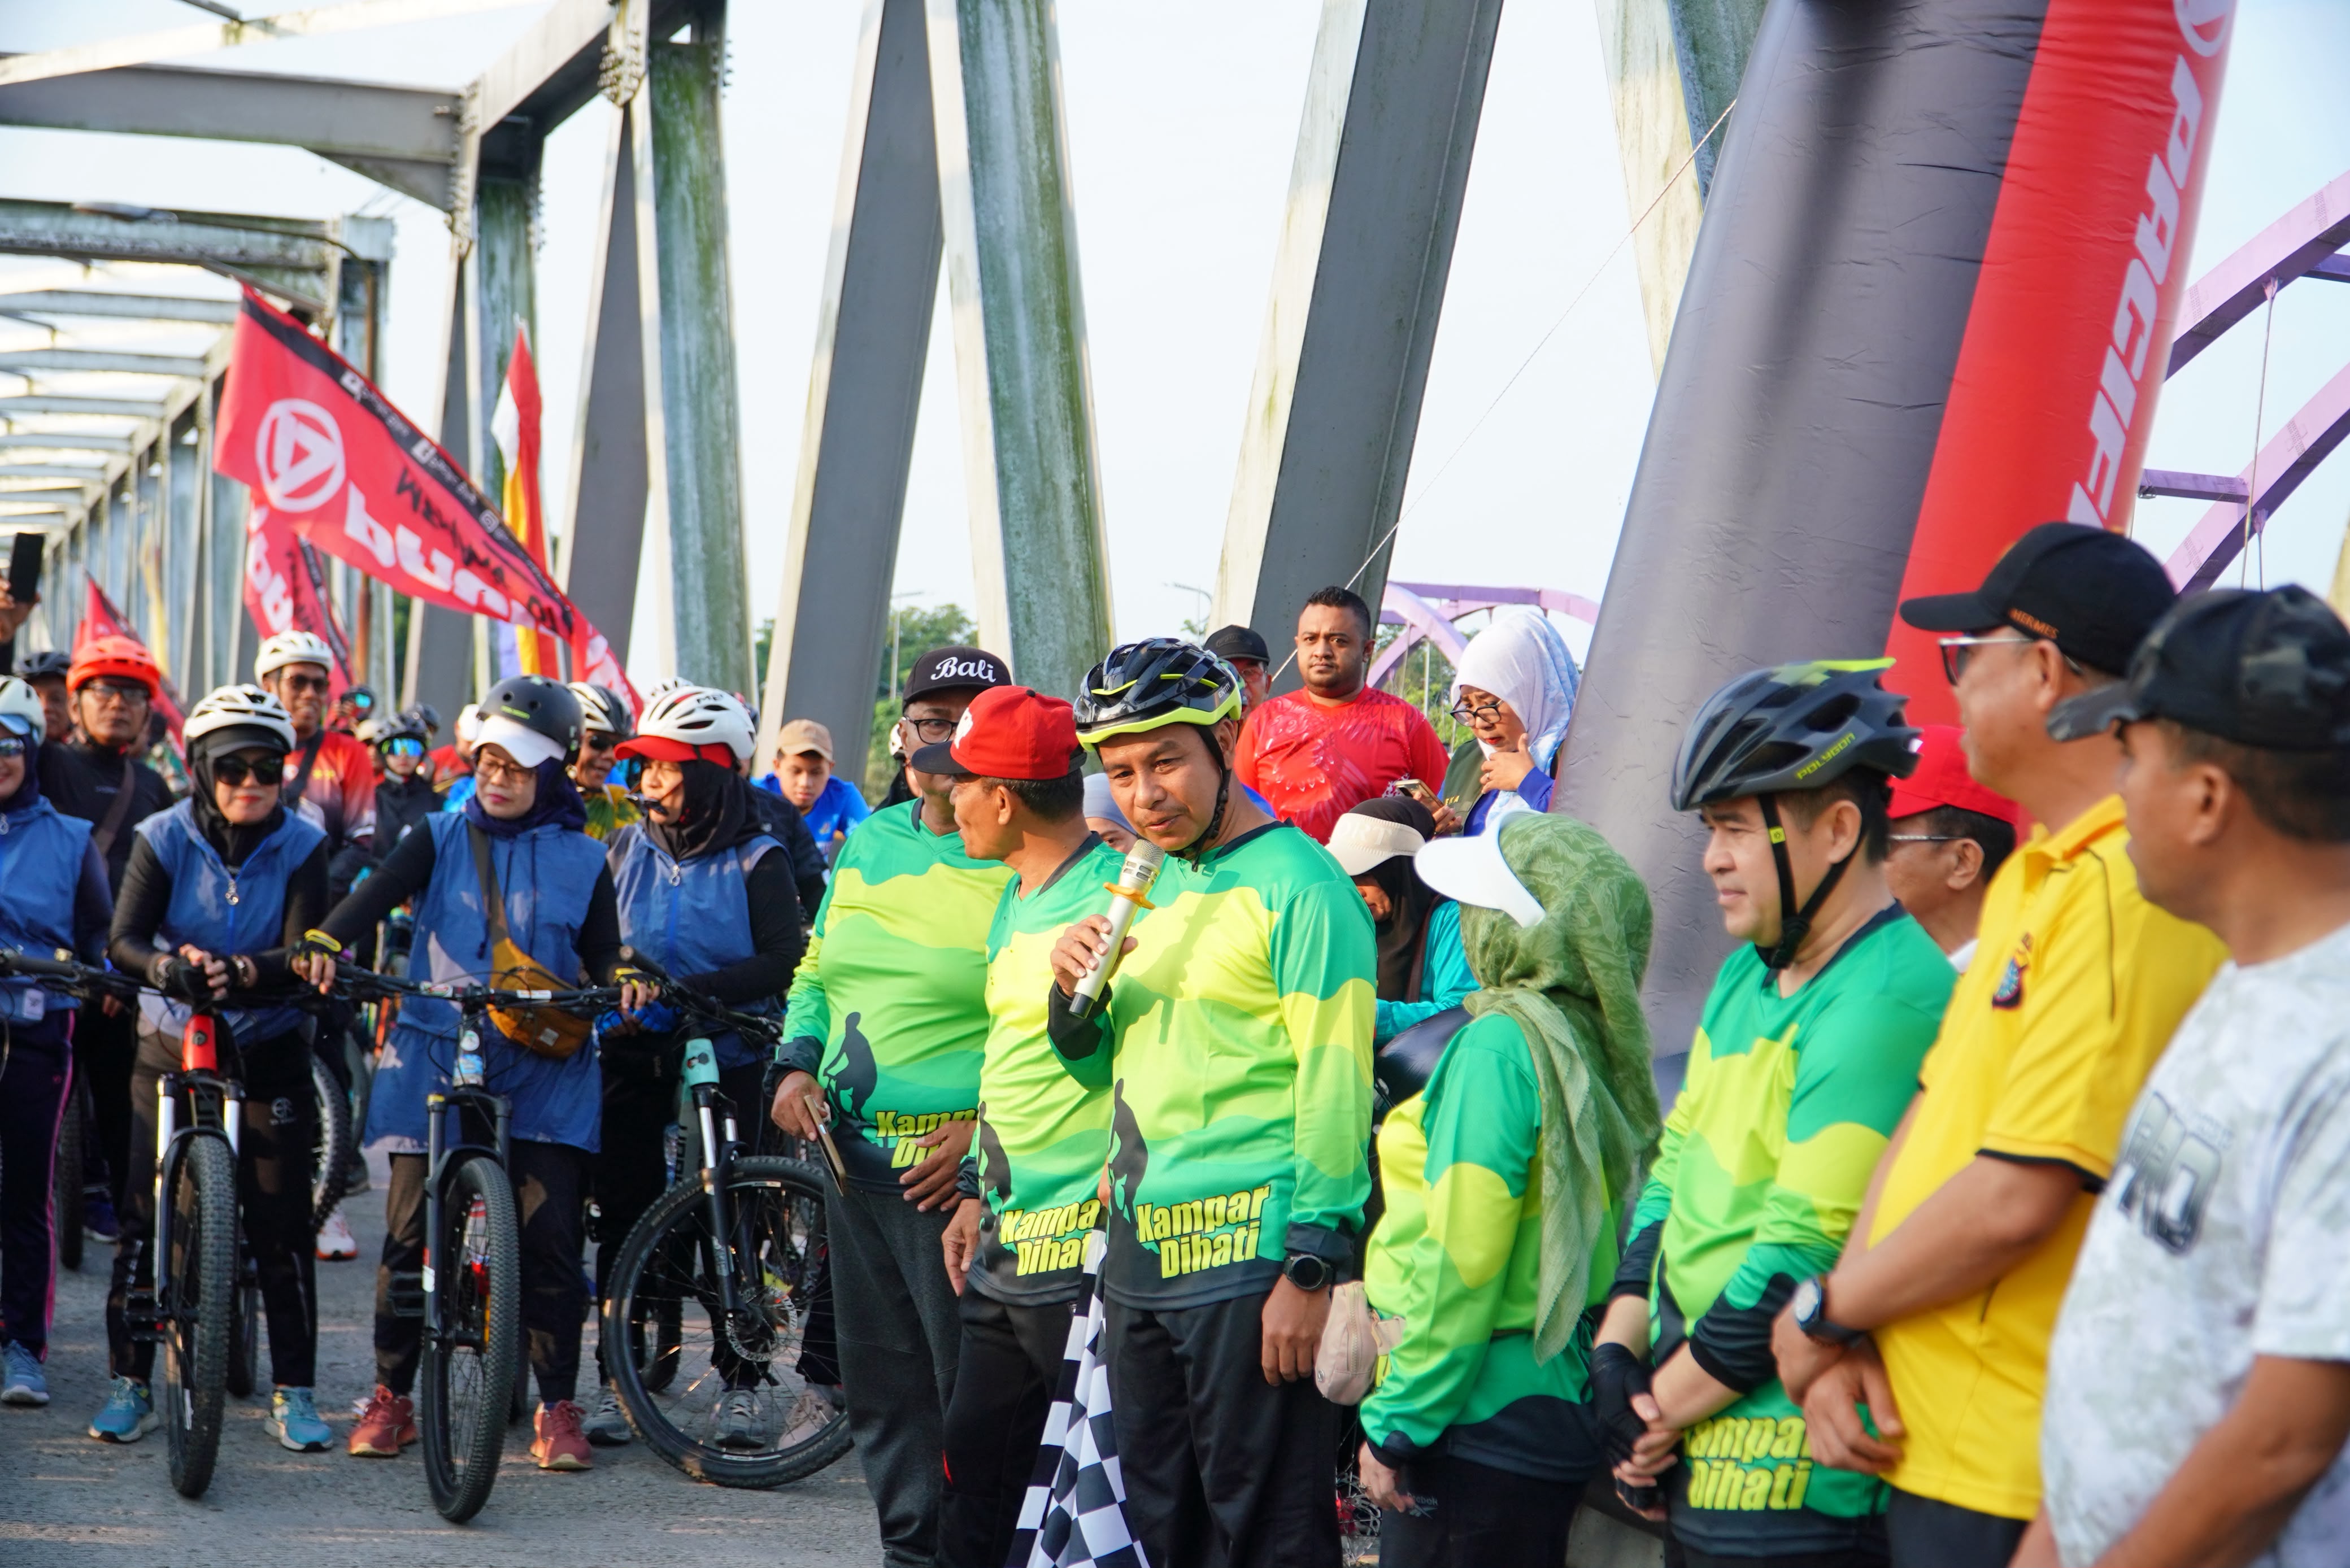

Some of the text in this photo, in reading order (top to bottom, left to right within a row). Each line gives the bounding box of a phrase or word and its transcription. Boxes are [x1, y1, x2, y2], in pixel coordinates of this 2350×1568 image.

[930, 656, 996, 683] Bali
[1218, 681, 1231, 698] ENTITY
[1796, 732, 1856, 779] POLYGON
[1334, 821, 1393, 846] ORT
[1000, 1198, 1105, 1245] Kampa
[1136, 1184, 1271, 1243] Kampar
[1016, 1232, 1093, 1277] Dihat
[1160, 1219, 1261, 1279] Dihati
[1687, 1459, 1814, 1511] Dihati
